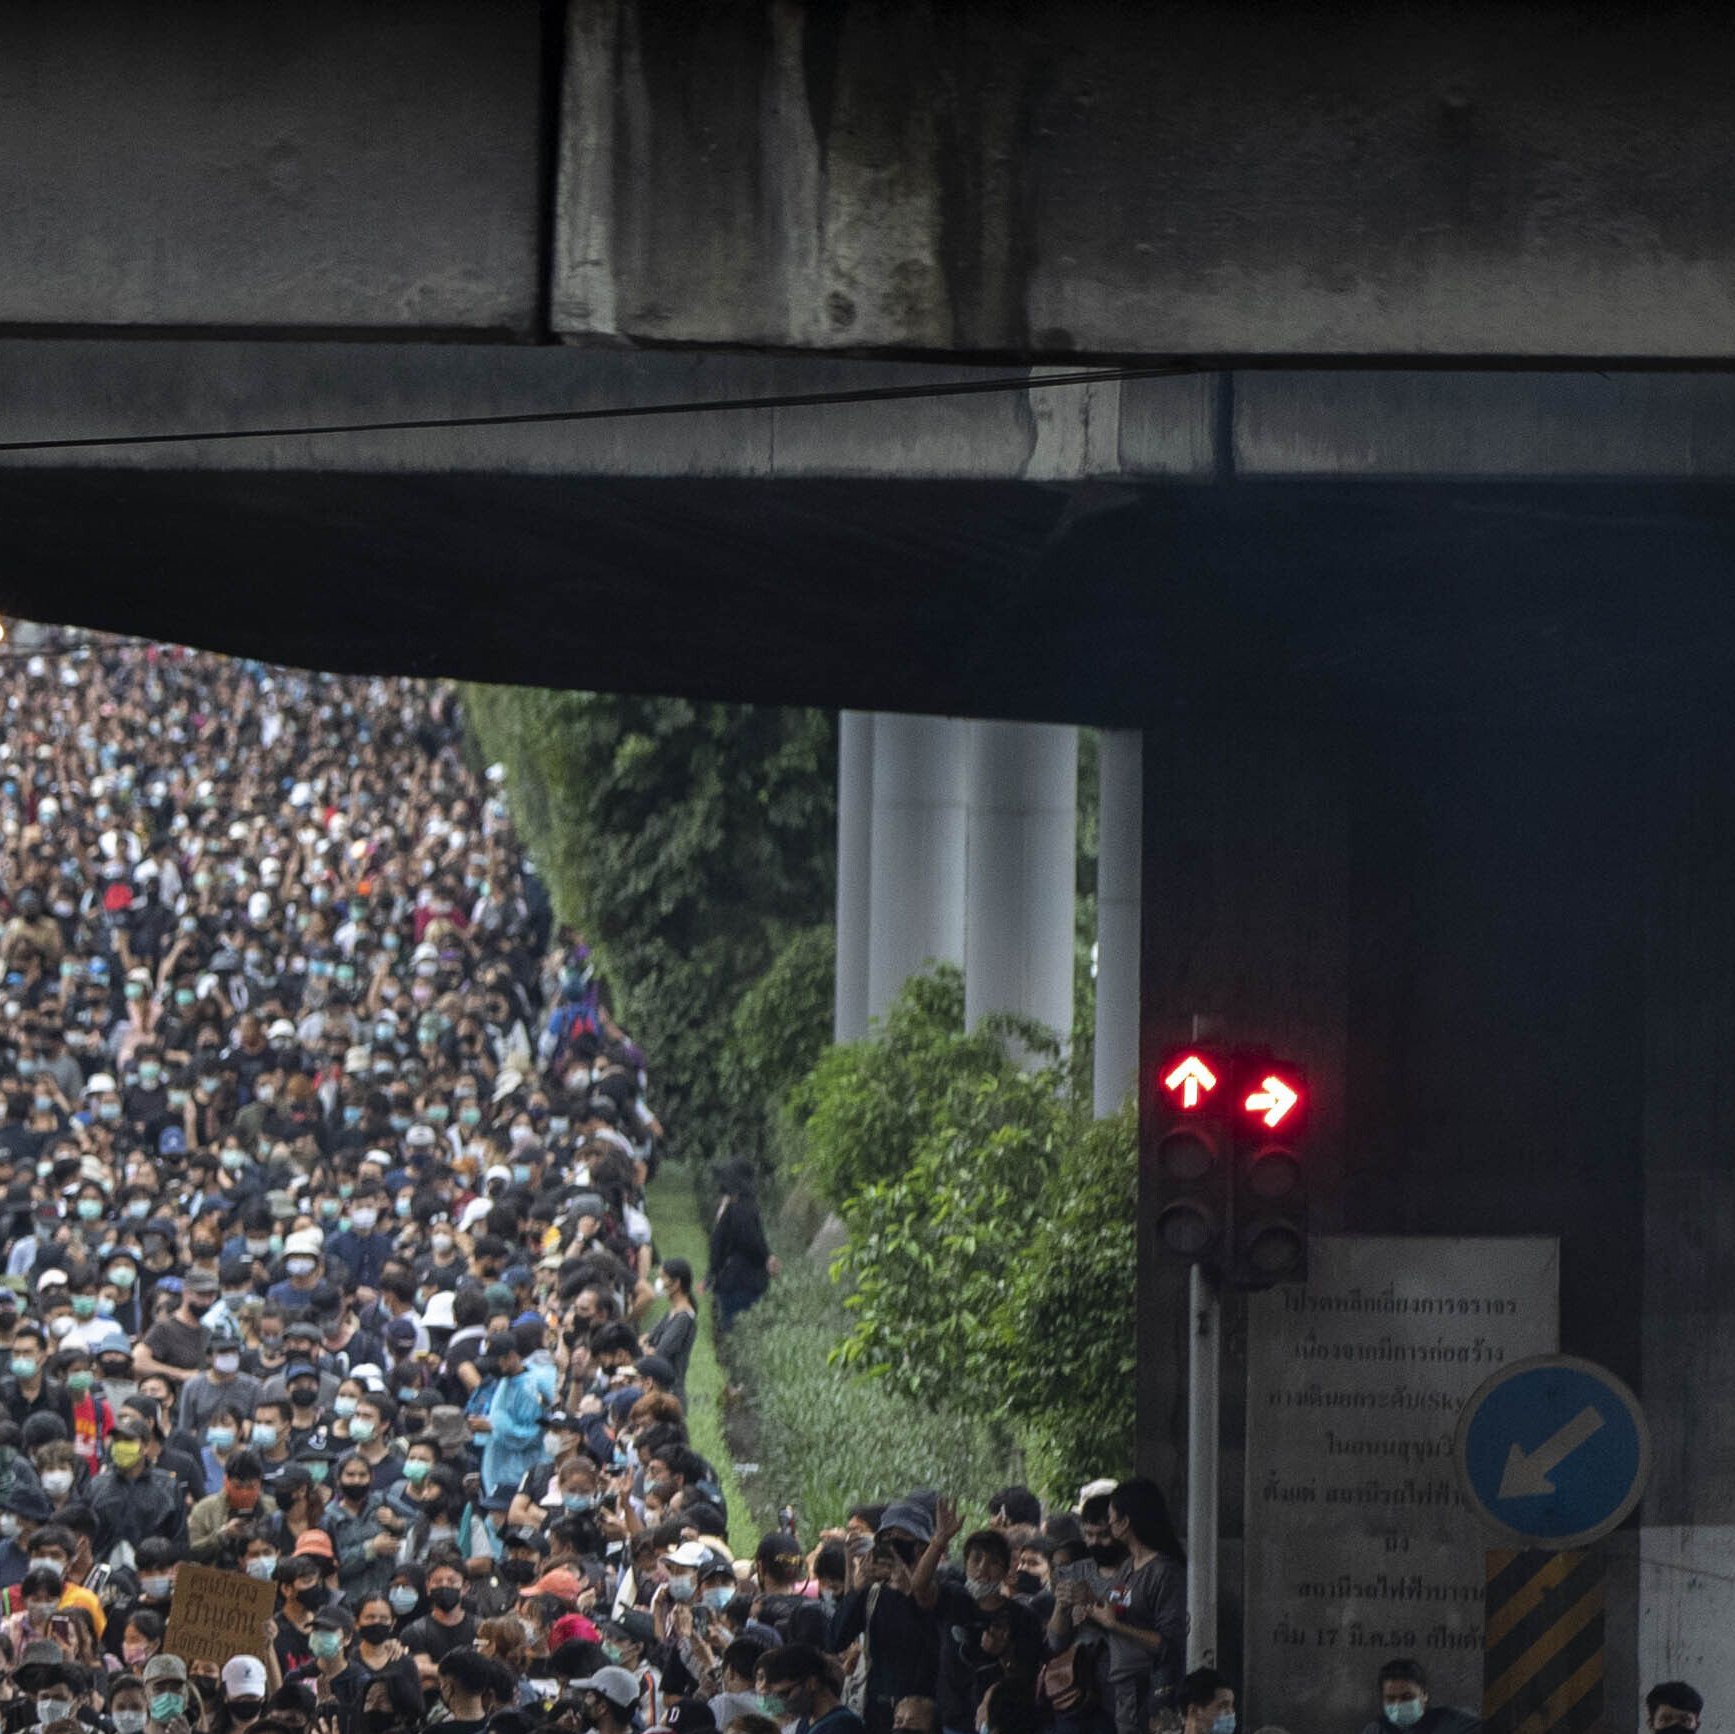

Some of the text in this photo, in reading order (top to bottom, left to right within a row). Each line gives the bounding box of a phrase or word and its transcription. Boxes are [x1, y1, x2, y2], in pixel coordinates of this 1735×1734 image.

[1295, 1328, 1504, 1361] เนื่องจากมีการก่อสร้าง
[1327, 1431, 1454, 1463] ในถนนสุขุมวิ
[1325, 1480, 1468, 1505] สถานีรถไฟฟ้า
[1297, 1573, 1486, 1602] สถานีรถไฟฟ้าบางน
[1426, 1625, 1487, 1650] เป็นต้
